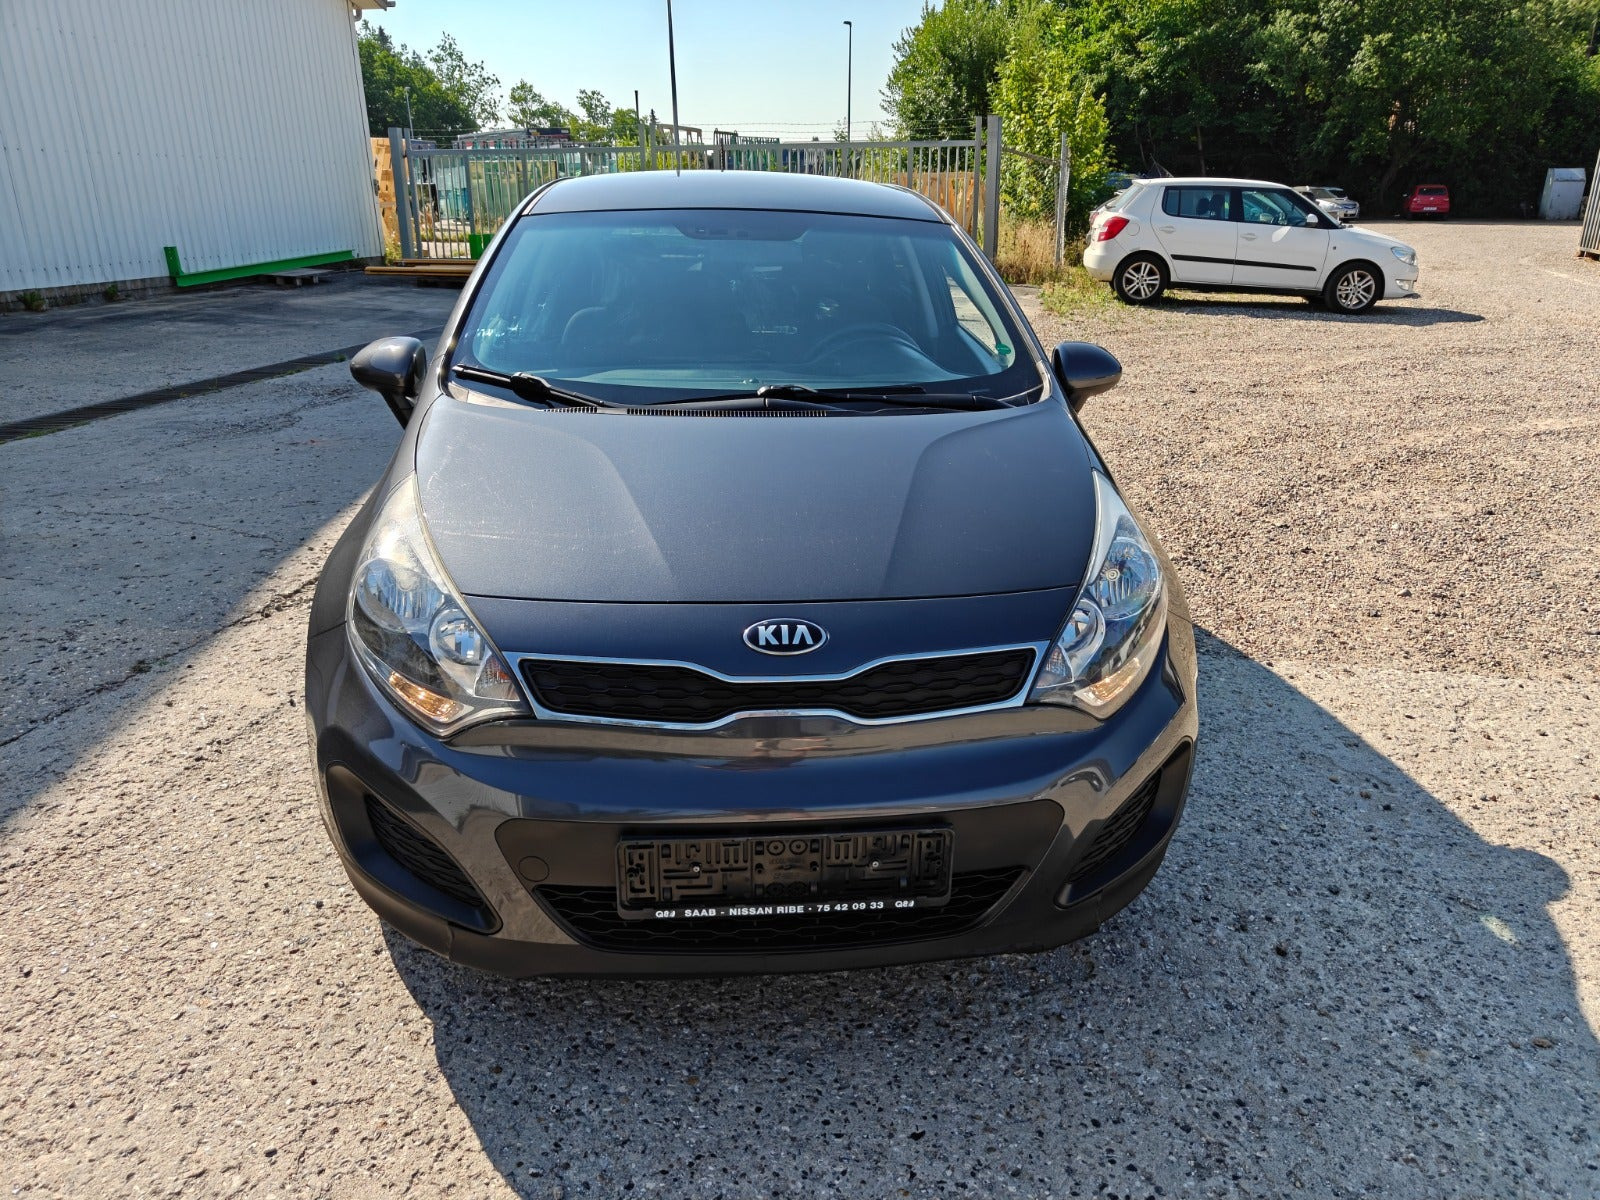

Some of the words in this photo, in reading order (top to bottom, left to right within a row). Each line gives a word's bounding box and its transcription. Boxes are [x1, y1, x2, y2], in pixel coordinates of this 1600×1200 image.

[758, 624, 814, 645] KIA
[684, 908, 716, 917] SAAB
[729, 906, 773, 916] NISSAN
[776, 905, 804, 914] RIBE
[816, 904, 831, 912] 75
[834, 903, 849, 911] 42
[852, 902, 866, 910] 09
[869, 901, 884, 909] 33
